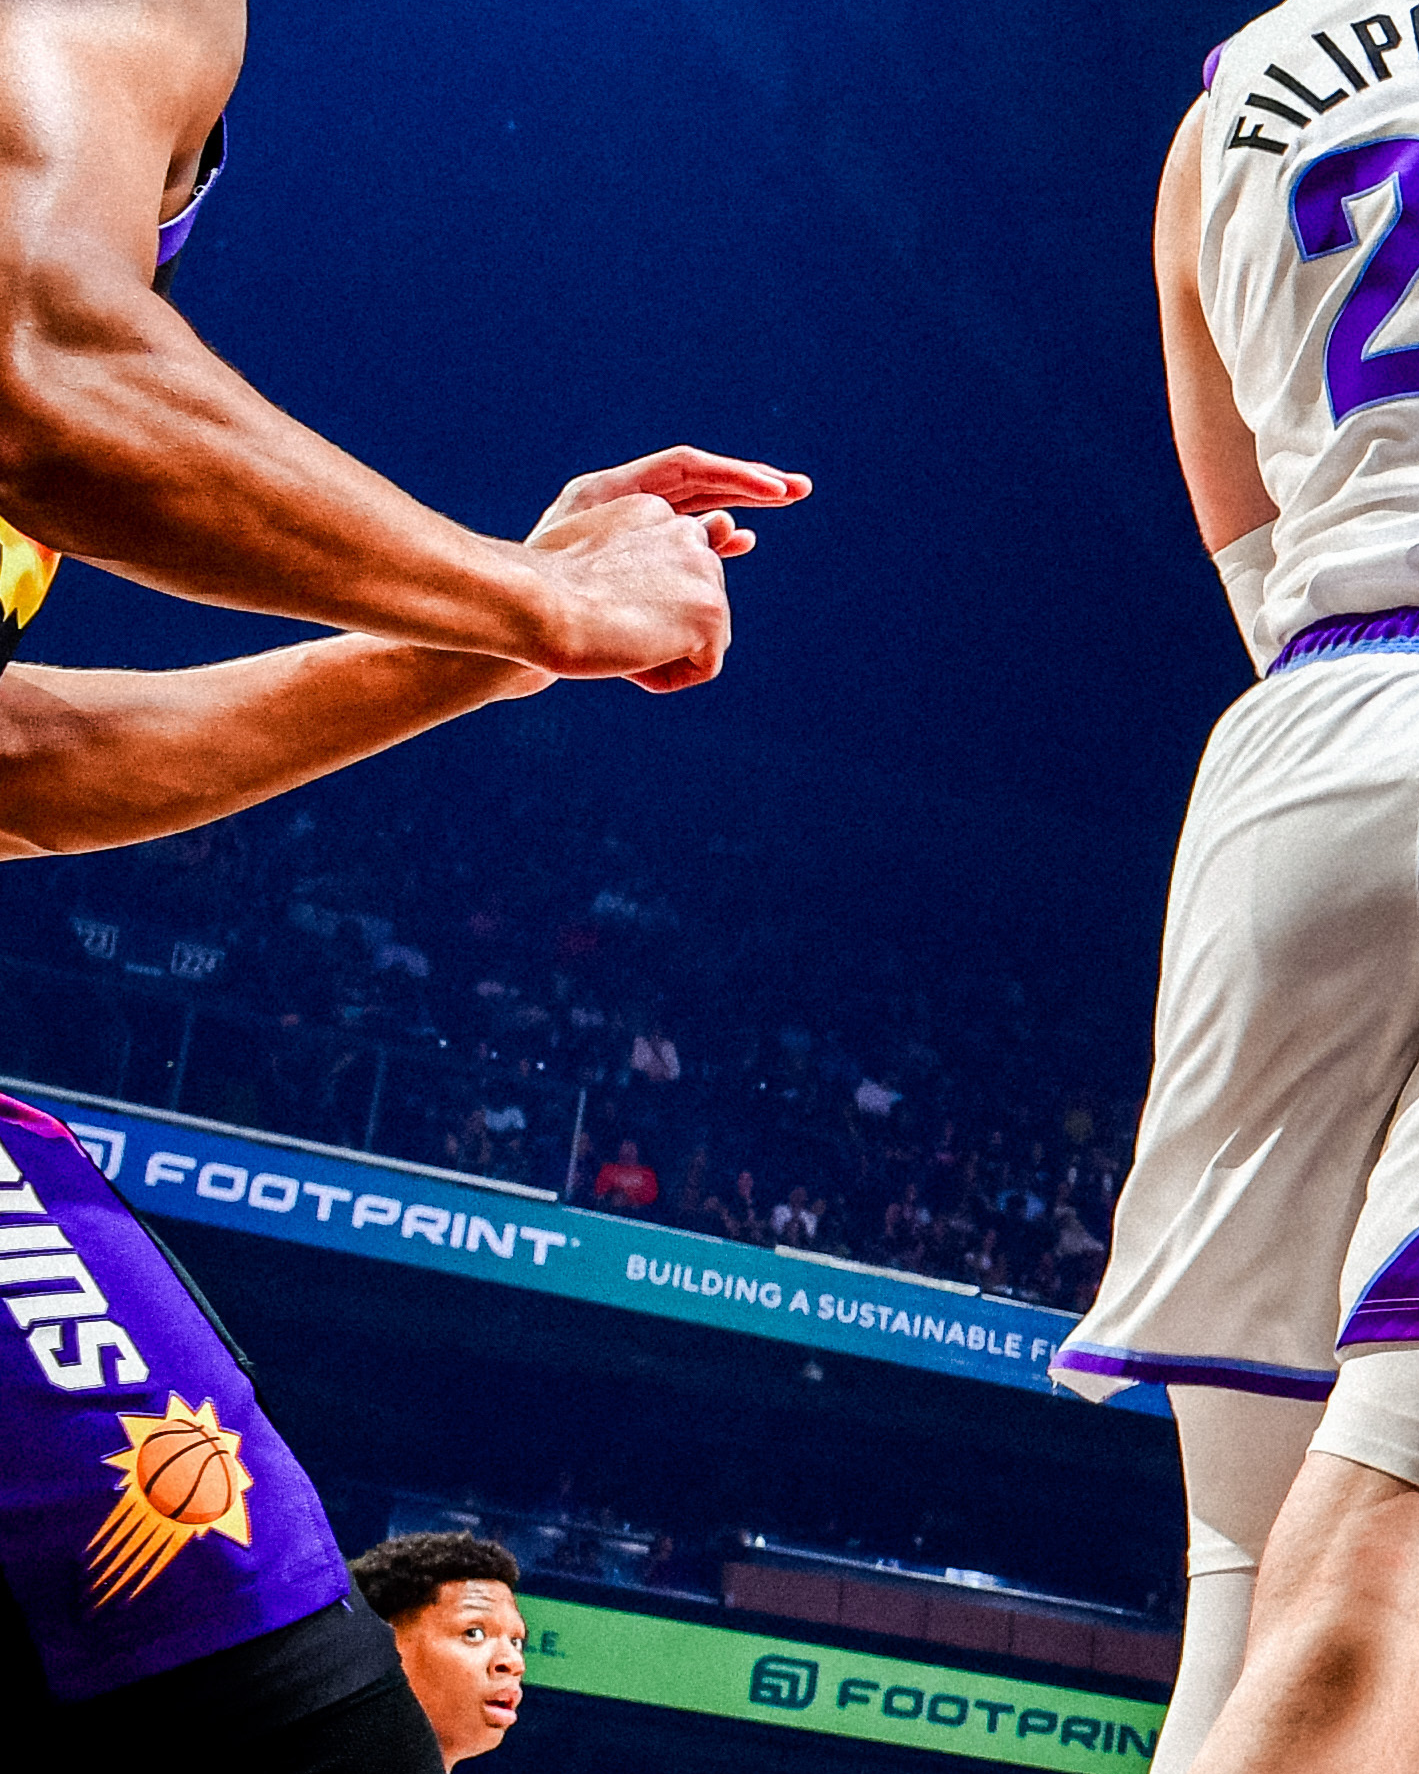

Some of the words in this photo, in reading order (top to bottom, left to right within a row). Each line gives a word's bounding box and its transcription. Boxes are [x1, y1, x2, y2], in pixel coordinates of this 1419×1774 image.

[144, 1151, 567, 1266] FOOTPRINT
[626, 1254, 782, 1310] BUILDING
[788, 1291, 810, 1316] A
[816, 1293, 1021, 1361] SUSTAINABLE
[836, 1679, 1157, 1758] FOOTPRIN
